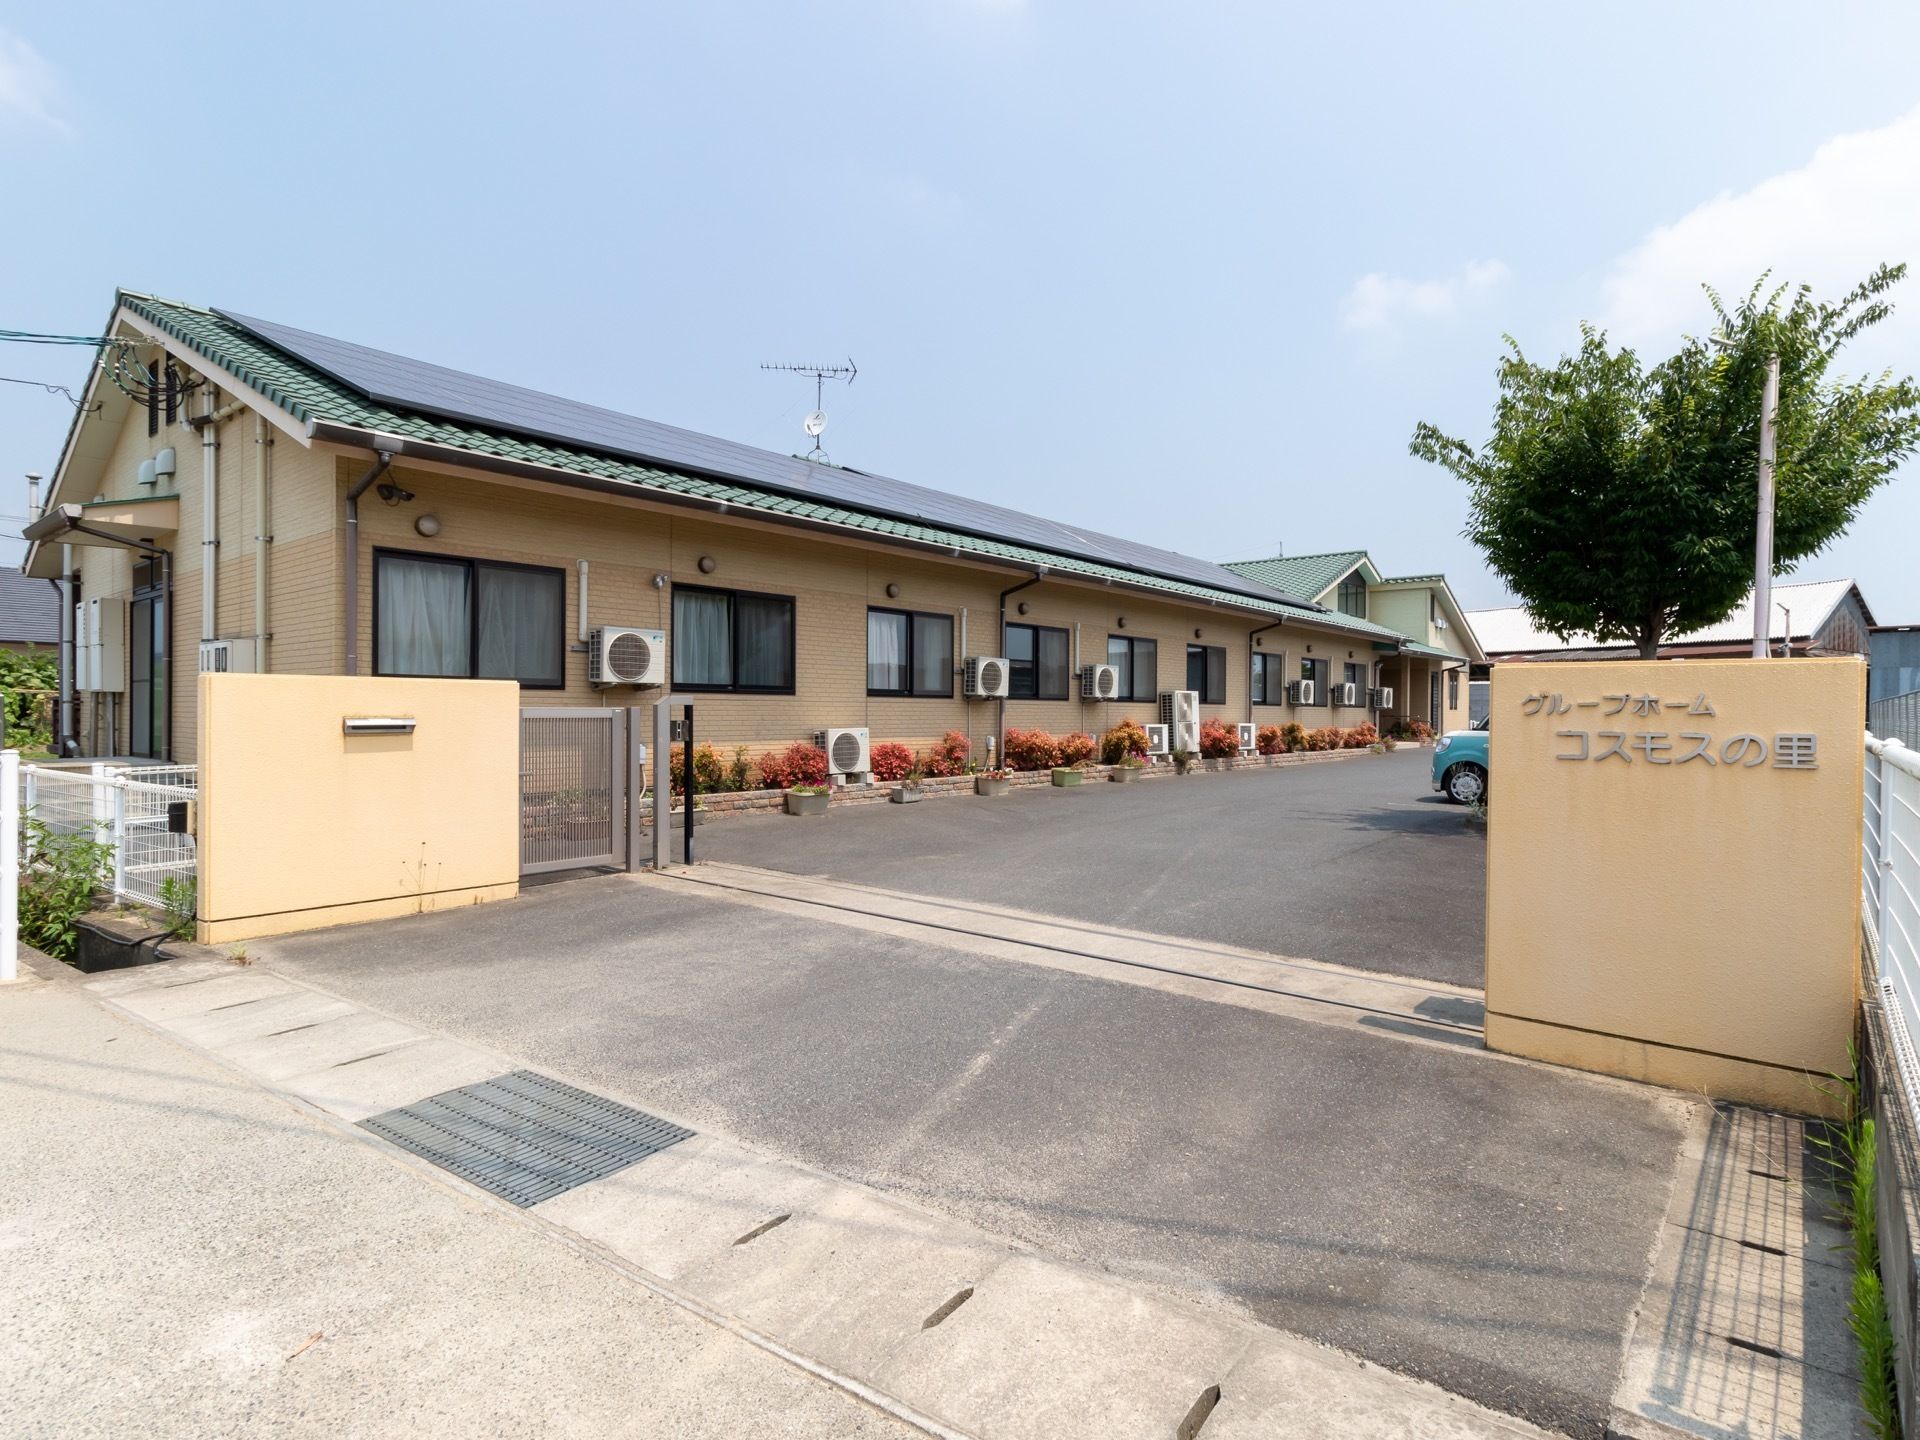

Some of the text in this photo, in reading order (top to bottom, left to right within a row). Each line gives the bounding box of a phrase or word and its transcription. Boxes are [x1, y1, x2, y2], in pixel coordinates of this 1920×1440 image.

[1522, 692, 1716, 717] グループホーム
[1555, 730, 1819, 769] コスモスの里
